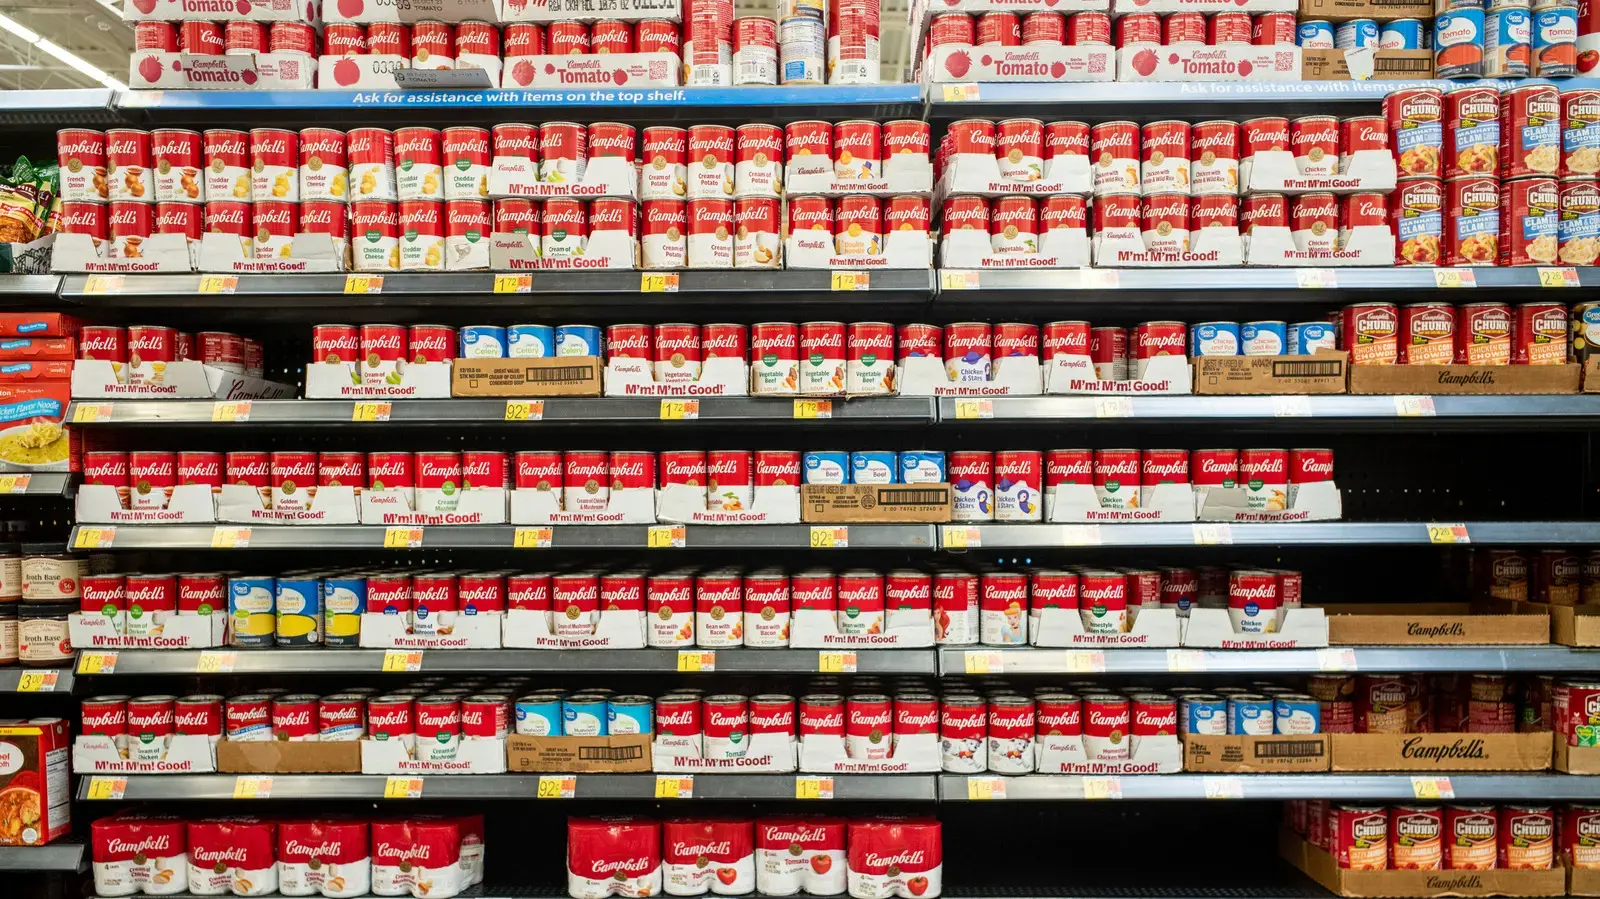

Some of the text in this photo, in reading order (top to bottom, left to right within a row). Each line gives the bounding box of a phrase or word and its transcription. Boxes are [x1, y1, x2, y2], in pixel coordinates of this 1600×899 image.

[1442, 29, 1471, 40] Tomato
[1005, 52, 1039, 61] Campbell's
[1192, 51, 1228, 60] Campbell's
[192, 59, 229, 69] Campbell's
[567, 60, 600, 70] Campbell's
[994, 61, 1048, 76] Tomato
[1181, 60, 1236, 75] Tomato
[185, 68, 240, 82] Tomato
[557, 69, 611, 83] Tomato
[1180, 83, 1208, 93] Ask
[1211, 82, 1232, 93] for
[1236, 83, 1312, 93] assistance
[1315, 81, 1349, 92] with
[1353, 83, 1390, 92] items
[353, 93, 379, 103] Ask
[384, 92, 404, 103] for
[408, 93, 482, 103] assistance
[487, 92, 518, 102] with
[523, 92, 562, 101] items
[590, 91, 614, 101] the
[618, 92, 643, 104] top
[647, 91, 686, 101] shelf.
[1402, 105, 1440, 117] CHUNKY
[1461, 104, 1499, 116] CHUNKY
[588, 133, 634, 151] Campbell's
[689, 134, 734, 151] Campbell's
[883, 130, 928, 147] Campbell's
[996, 131, 1041, 149] Campbell's
[1400, 134, 1424, 147] CLAM
[1458, 134, 1482, 146] CLAM
[443, 138, 488, 154] Campbell's
[498, 164, 525, 172] Campbell's
[508, 184, 607, 195] M'm! M'm! Good!
[1284, 179, 1359, 188] M'm! M'm! Good!
[884, 206, 929, 222] Campbell's
[1040, 206, 1086, 222] Campbell's
[1118, 251, 1218, 262] M'm! M'm! Good!
[233, 261, 305, 270] M'm! M'm! Good!
[848, 333, 892, 350] Campbell's
[1140, 332, 1185, 348] Campbell's
[1438, 370, 1494, 386] Campbell's
[626, 384, 724, 395] M'm! M'm! Good!
[958, 387, 980, 395] M'm!
[982, 387, 1008, 395] Good!
[16, 400, 59, 414] Flavor Noodle
[110, 511, 183, 520] M'm! M'm! Good!
[383, 513, 481, 524] M'm! M'm! Good!
[1087, 511, 1160, 520] M'm! M'm! Good!
[553, 586, 597, 602] Campbell's
[697, 587, 740, 603] Campbell's
[1032, 584, 1076, 600] Campbell's
[1229, 583, 1276, 600] Campbell's
[1407, 622, 1463, 638] Campbell's
[93, 636, 188, 646] M'm! M'm! Good!
[226, 706, 268, 721] Campbell's
[988, 712, 1034, 729] Campbell's
[941, 713, 986, 730] Campbell's
[1402, 736, 1485, 762] Campbell's
[95, 760, 191, 771] M'm! M'm! Good!
[1061, 763, 1159, 773] M'm! M'm! Good!
[765, 827, 826, 842] Campbell's
[1399, 823, 1439, 836] CHUNKY
[107, 834, 169, 854] Campbell's
[285, 840, 341, 858] Campbell's
[377, 842, 430, 860] Campbell's
[674, 841, 730, 856] Campbell's
[194, 847, 247, 863] Campbell's
[865, 850, 924, 867] Campbell's
[592, 856, 649, 873] Campbell's
[692, 869, 715, 879] Tomato
[1426, 875, 1482, 889] Campbell's
